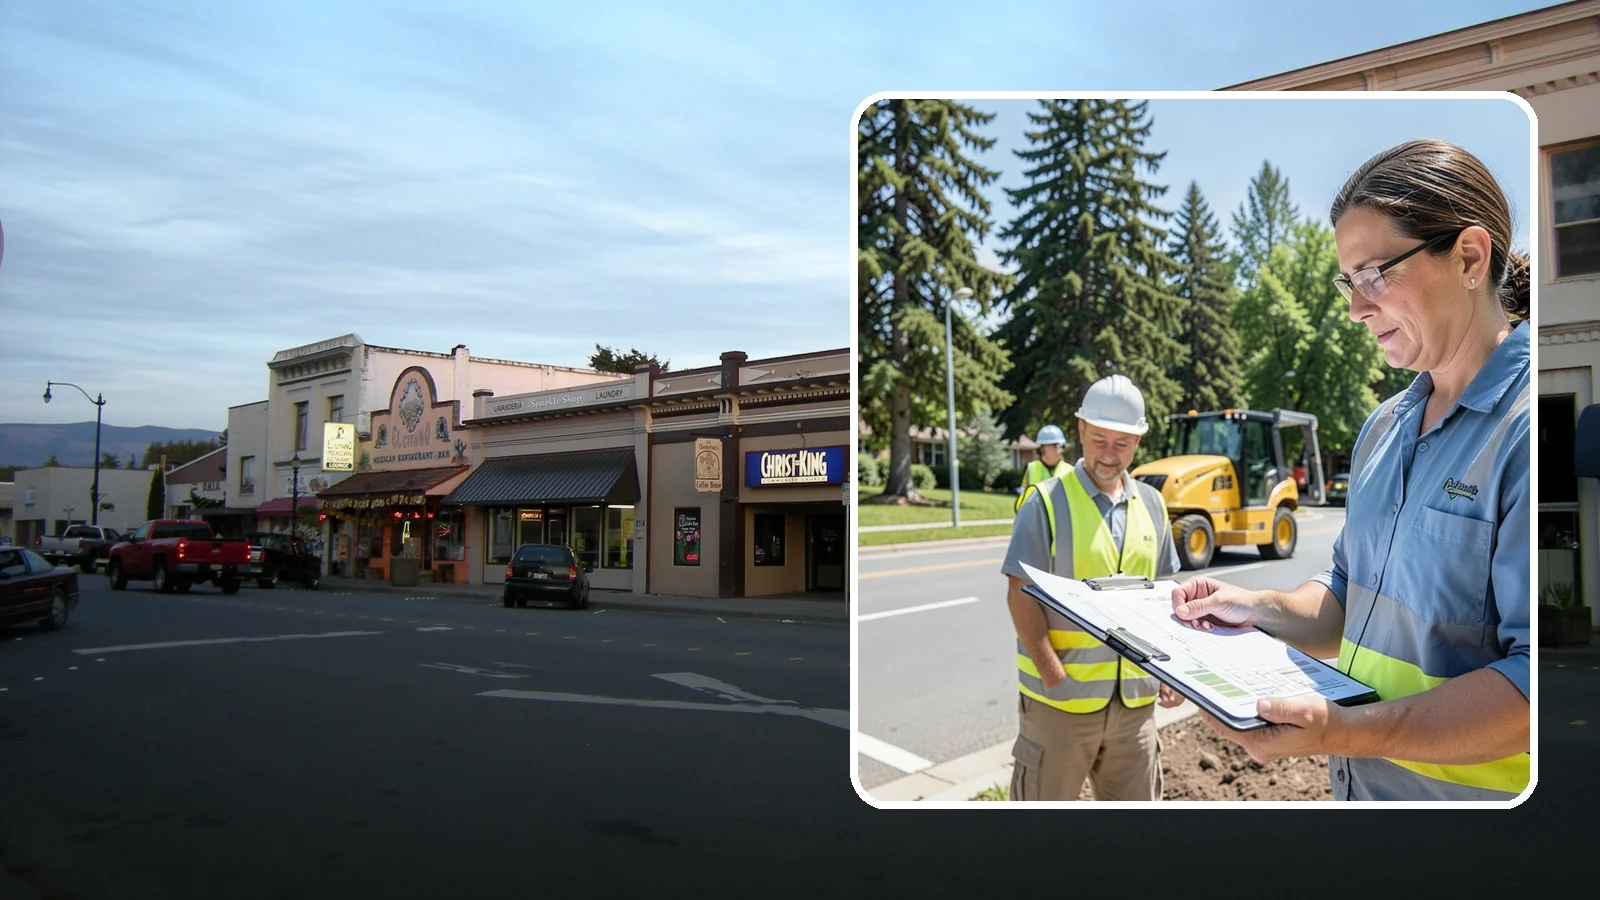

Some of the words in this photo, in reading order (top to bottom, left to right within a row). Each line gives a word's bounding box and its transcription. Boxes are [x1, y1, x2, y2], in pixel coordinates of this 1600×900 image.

[595, 389, 624, 400] LAUNDRY
[493, 402, 523, 413] LAVANDERIA
[531, 398, 560, 409] Sparkle
[561, 394, 582, 406] Shop
[373, 455, 396, 464] MEXICAN
[397, 452, 433, 462] RESTAURANT
[438, 450, 450, 459] BAR
[761, 452, 797, 478] CHRIST
[799, 450, 827, 476] KING
[697, 481, 709, 489] Coffee
